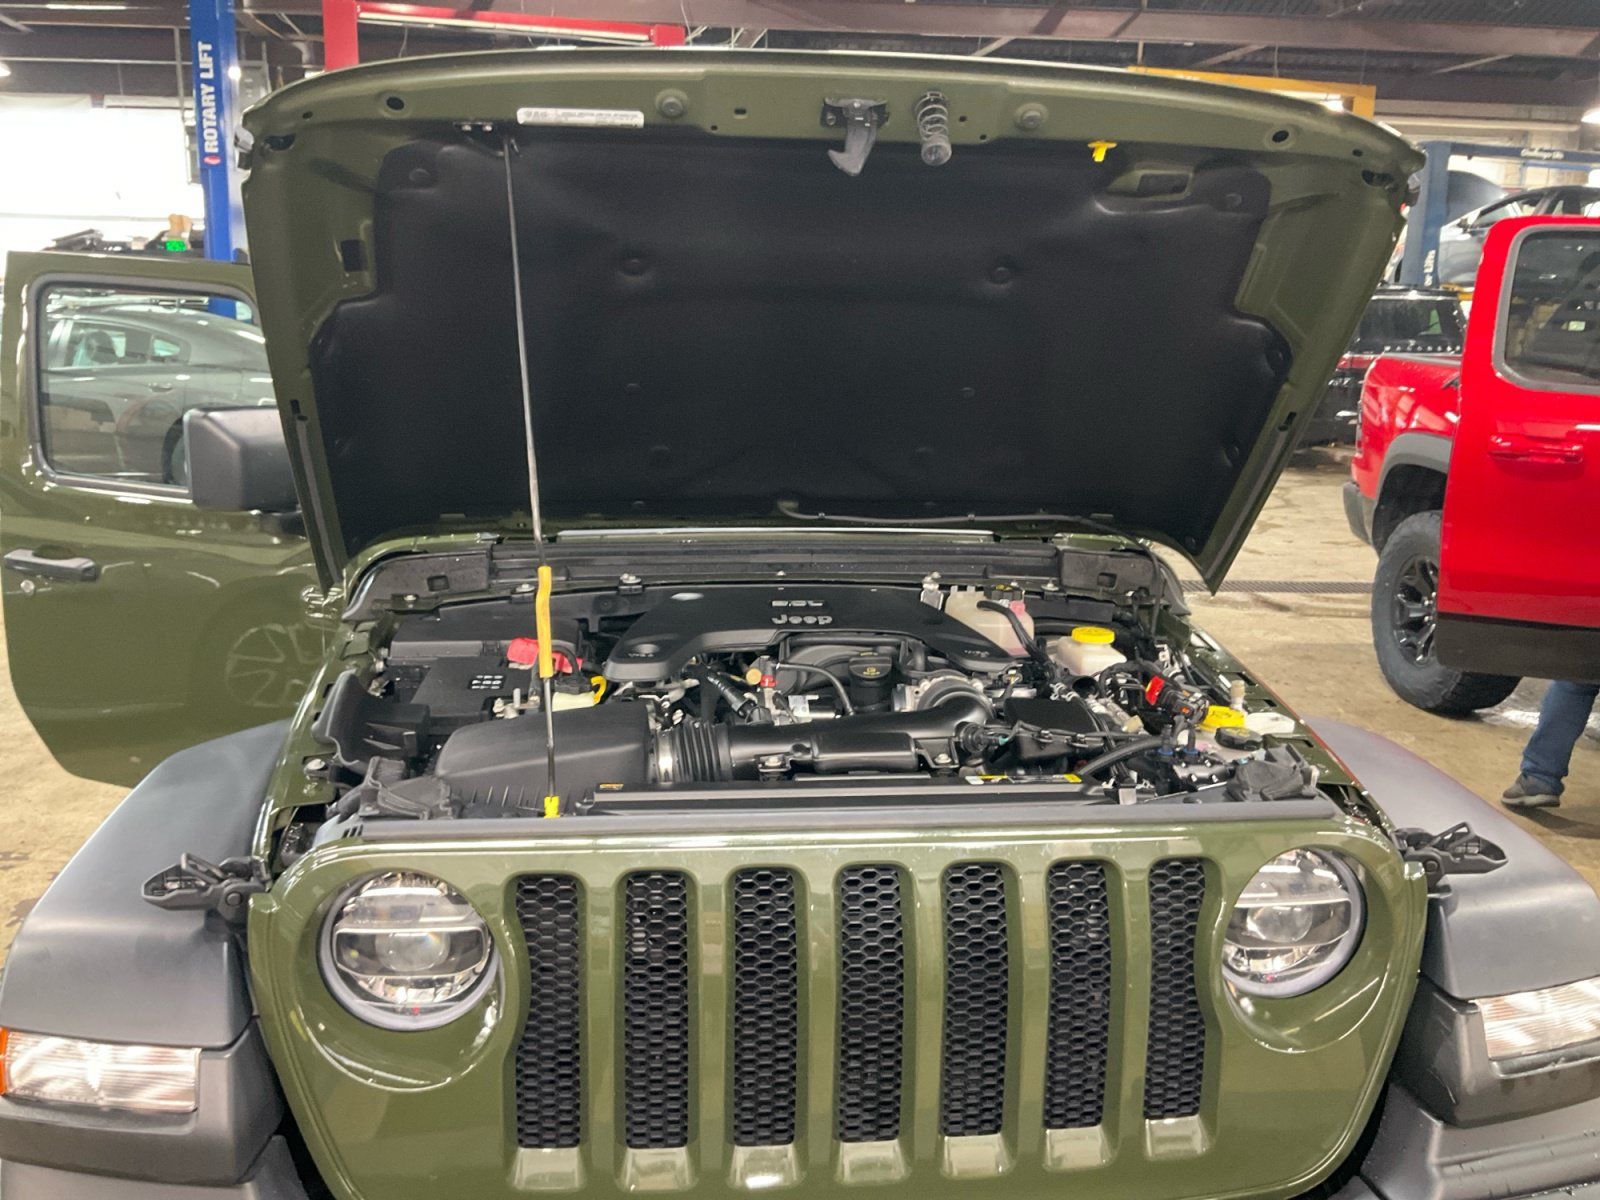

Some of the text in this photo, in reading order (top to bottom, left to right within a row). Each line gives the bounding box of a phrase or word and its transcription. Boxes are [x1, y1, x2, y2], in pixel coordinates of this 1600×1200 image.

[197, 41, 214, 79] LIFT
[200, 83, 219, 154] ROTARY
[771, 614, 833, 625] Jeep
